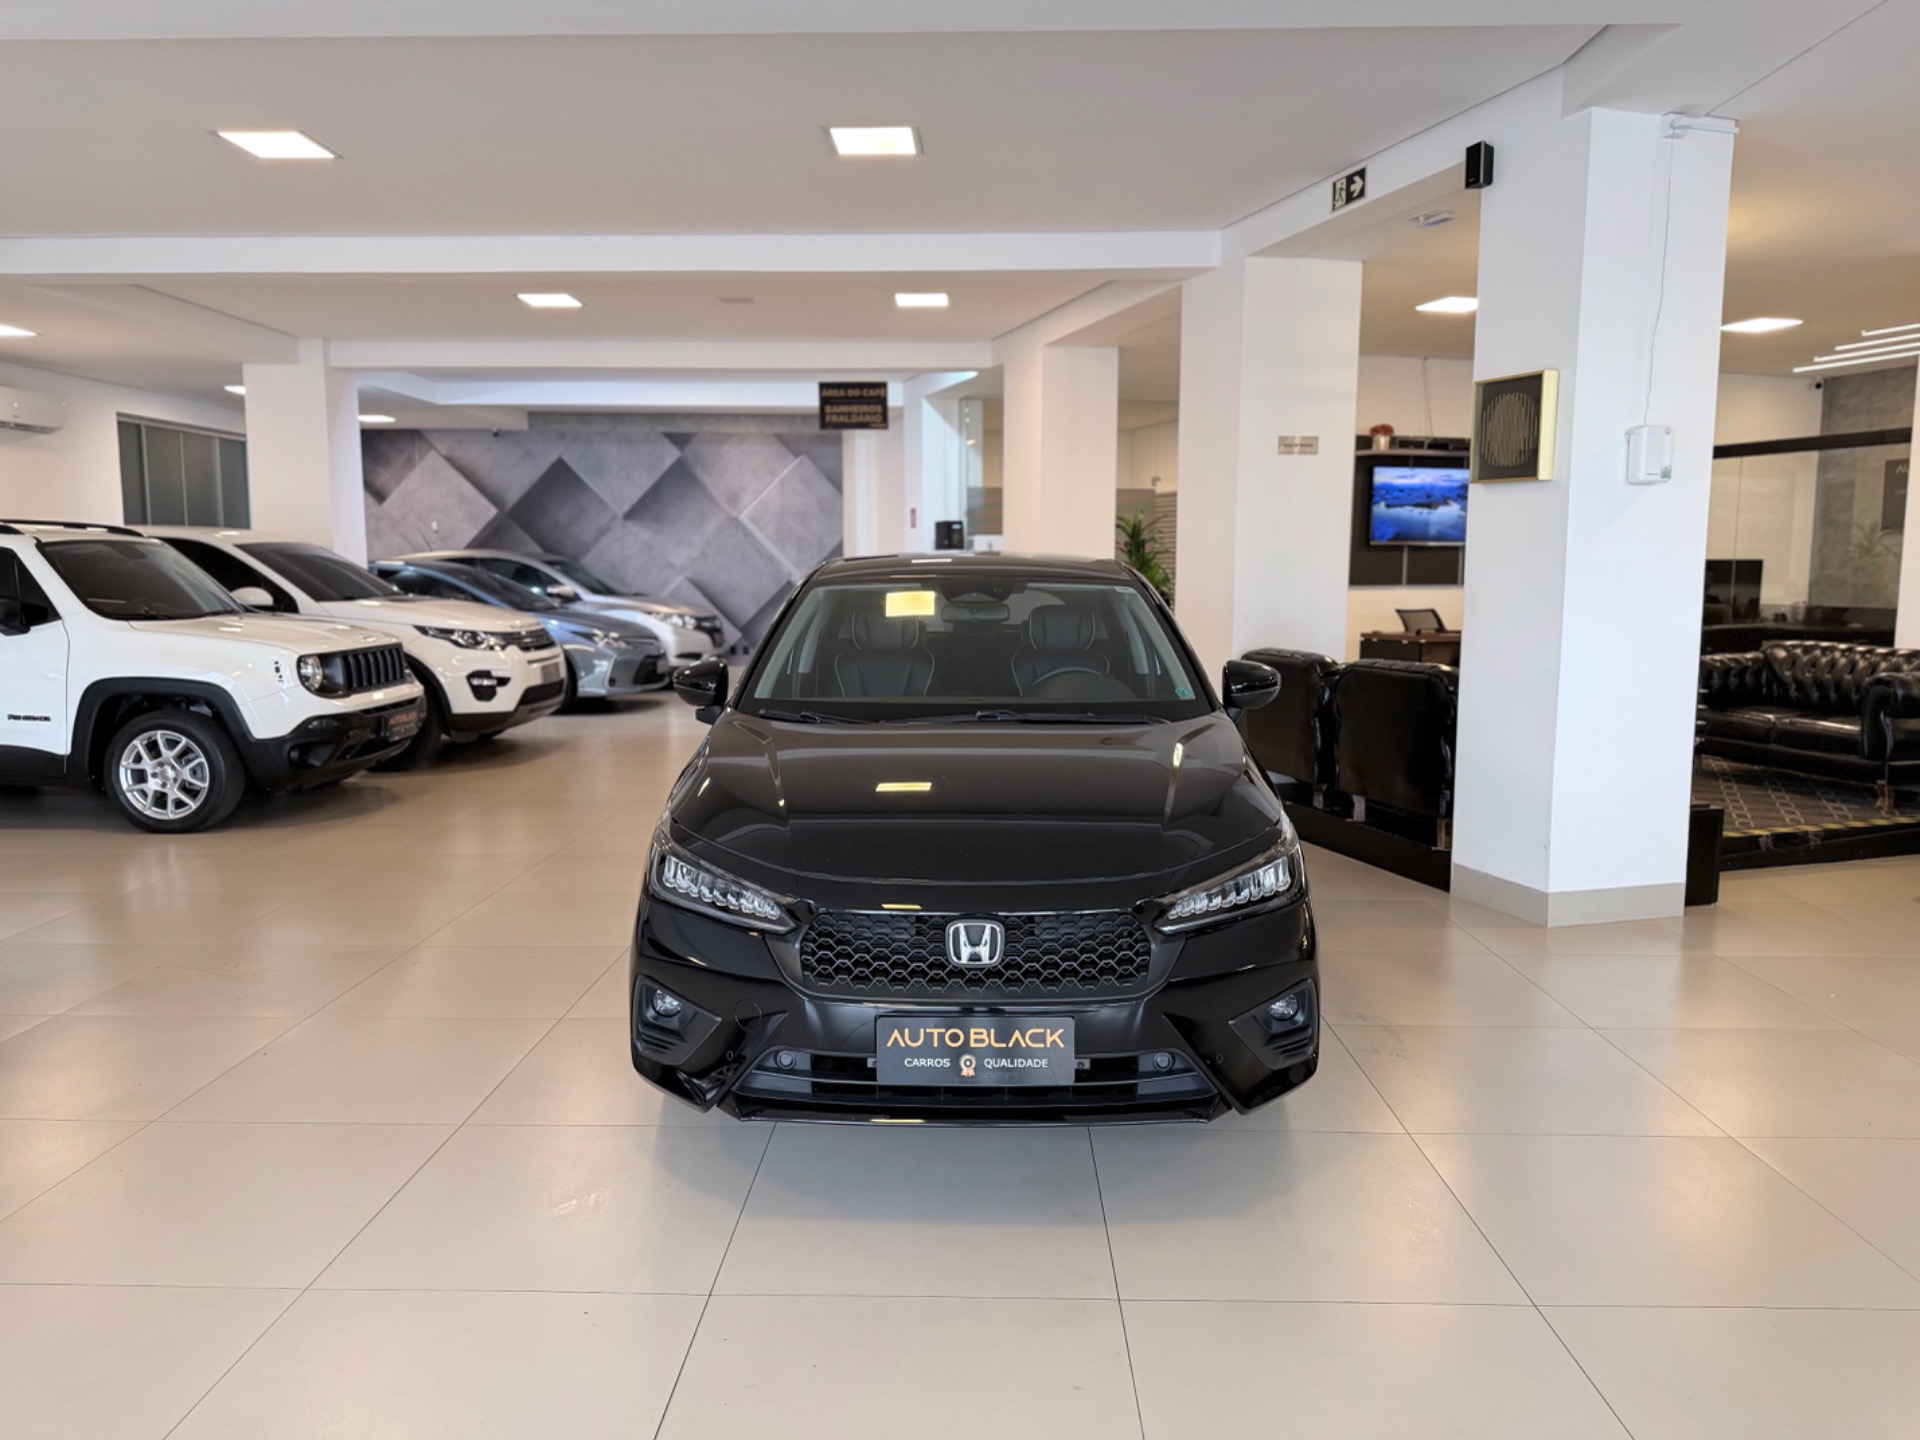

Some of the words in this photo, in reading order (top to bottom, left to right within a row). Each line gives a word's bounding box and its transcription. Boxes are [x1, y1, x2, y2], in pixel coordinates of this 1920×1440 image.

[847, 388, 861, 397] DO
[886, 1028, 964, 1048] AUTO
[970, 1028, 1065, 1048] BLACK
[904, 1058, 950, 1068] CARROS
[984, 1058, 1049, 1069] QUALIDADE
